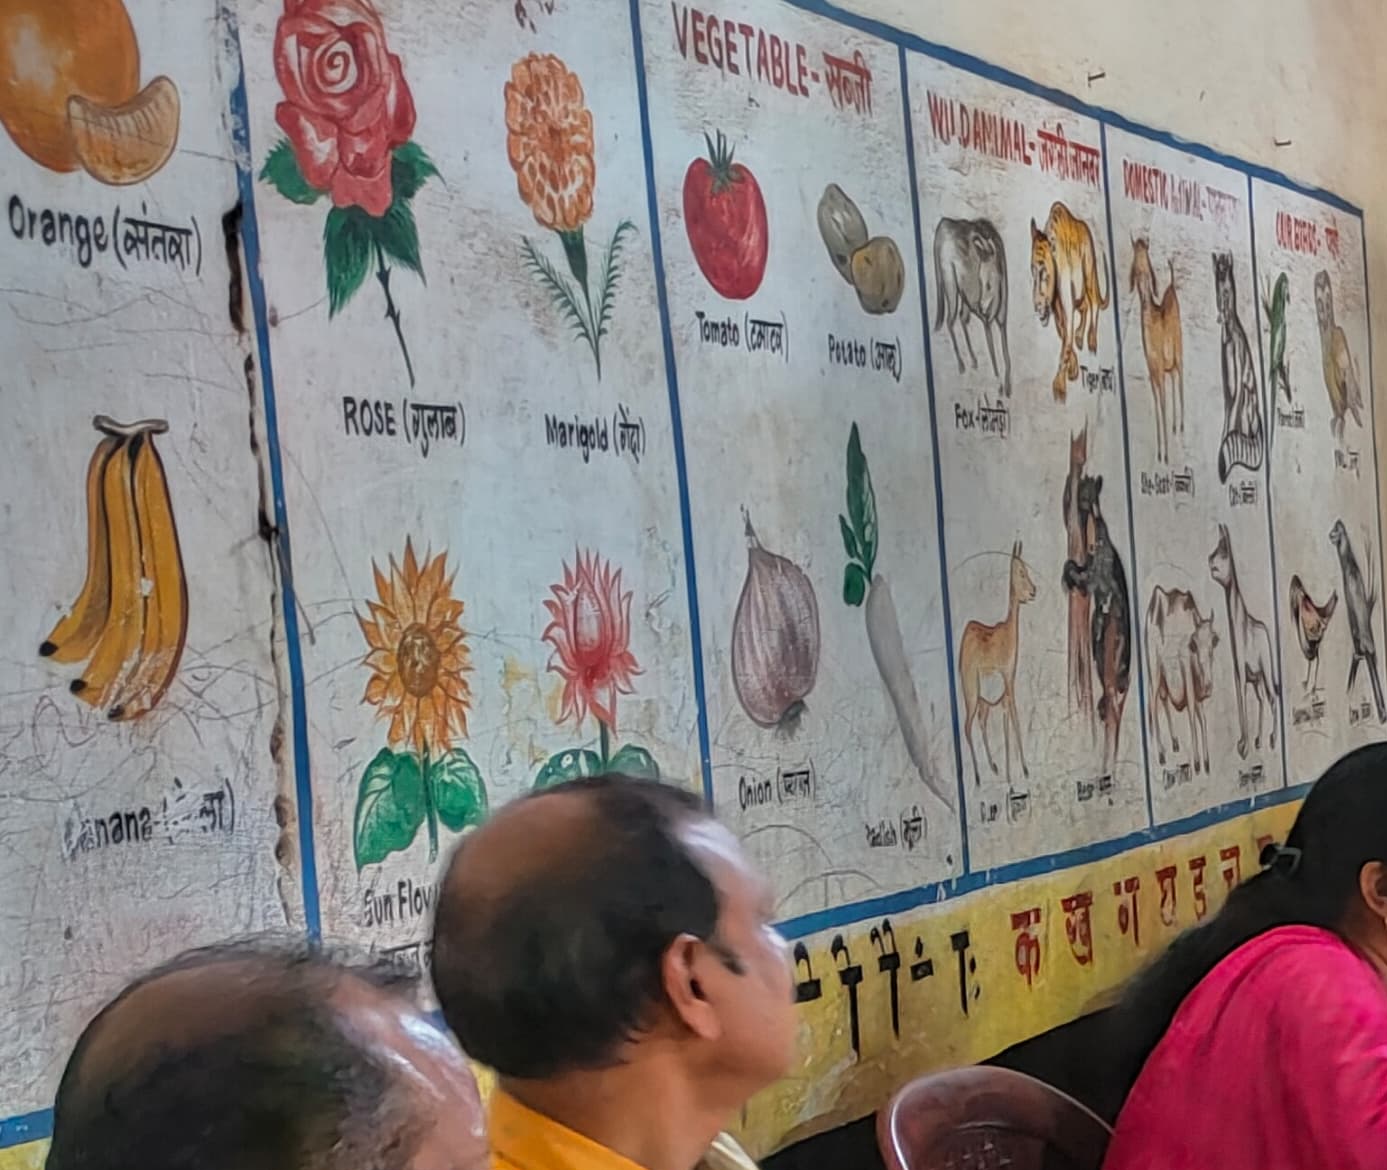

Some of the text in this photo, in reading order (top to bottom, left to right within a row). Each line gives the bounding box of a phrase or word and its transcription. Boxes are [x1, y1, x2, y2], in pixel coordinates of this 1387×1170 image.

[695, 311, 740, 347] Tomato
[343, 396, 396, 436] ROSE
[545, 413, 609, 464] Marigold
[739, 776, 772, 811] Onion
[364, 879, 438, 928] Sun Flow
